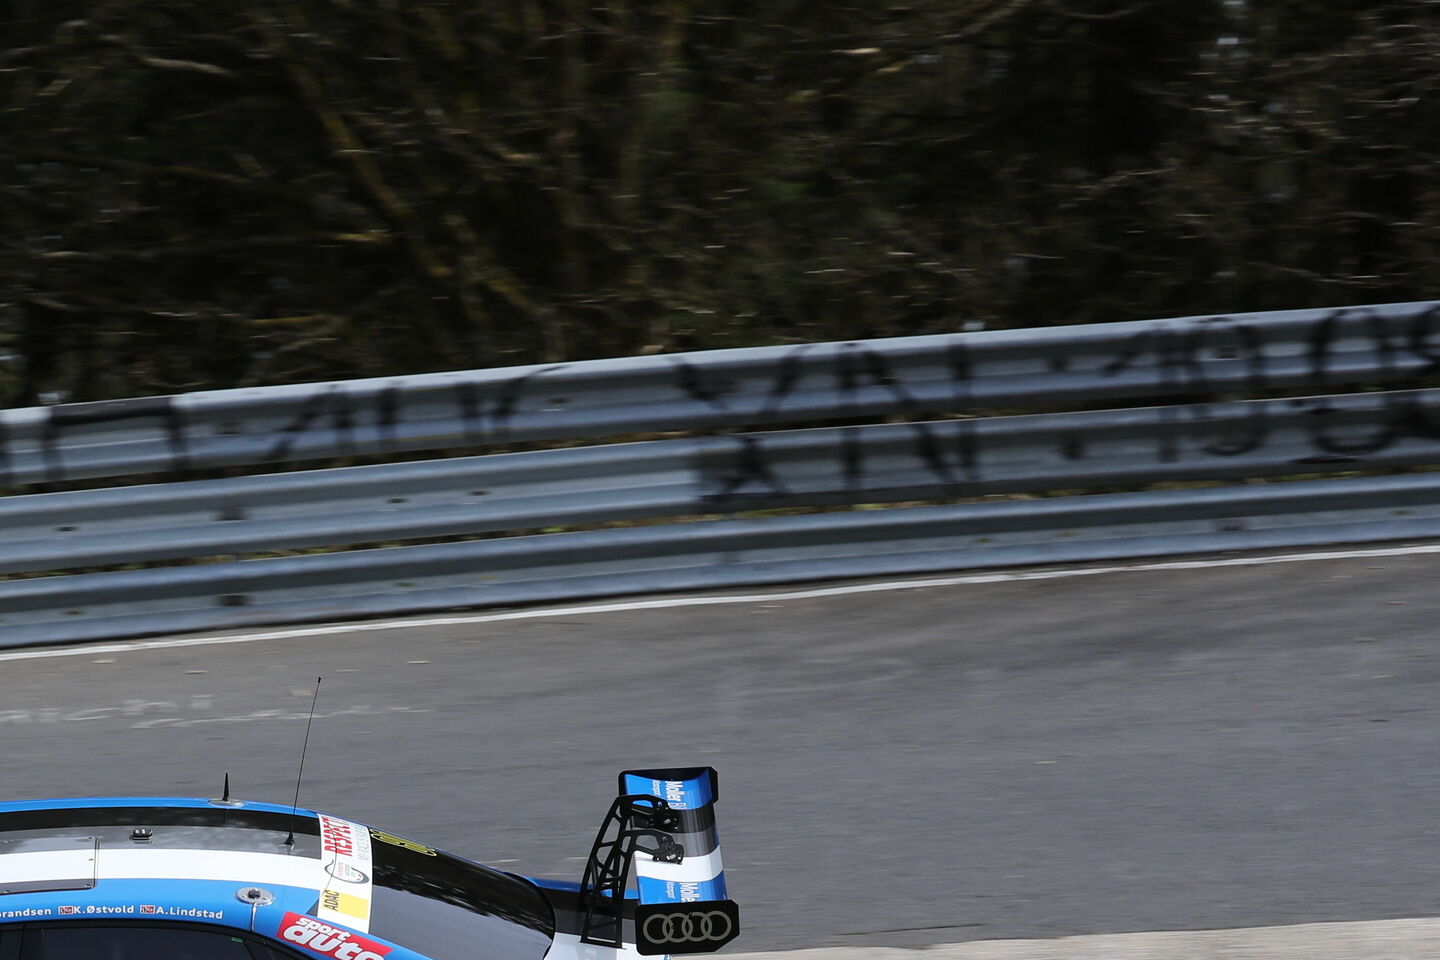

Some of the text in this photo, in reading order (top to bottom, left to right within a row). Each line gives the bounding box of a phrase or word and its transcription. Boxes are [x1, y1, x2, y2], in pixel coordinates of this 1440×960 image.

[73, 905, 135, 914] K.Østvold
[323, 889, 340, 912] ADAC
[156, 906, 224, 919] A.Lindstad
[295, 917, 352, 941] sport
